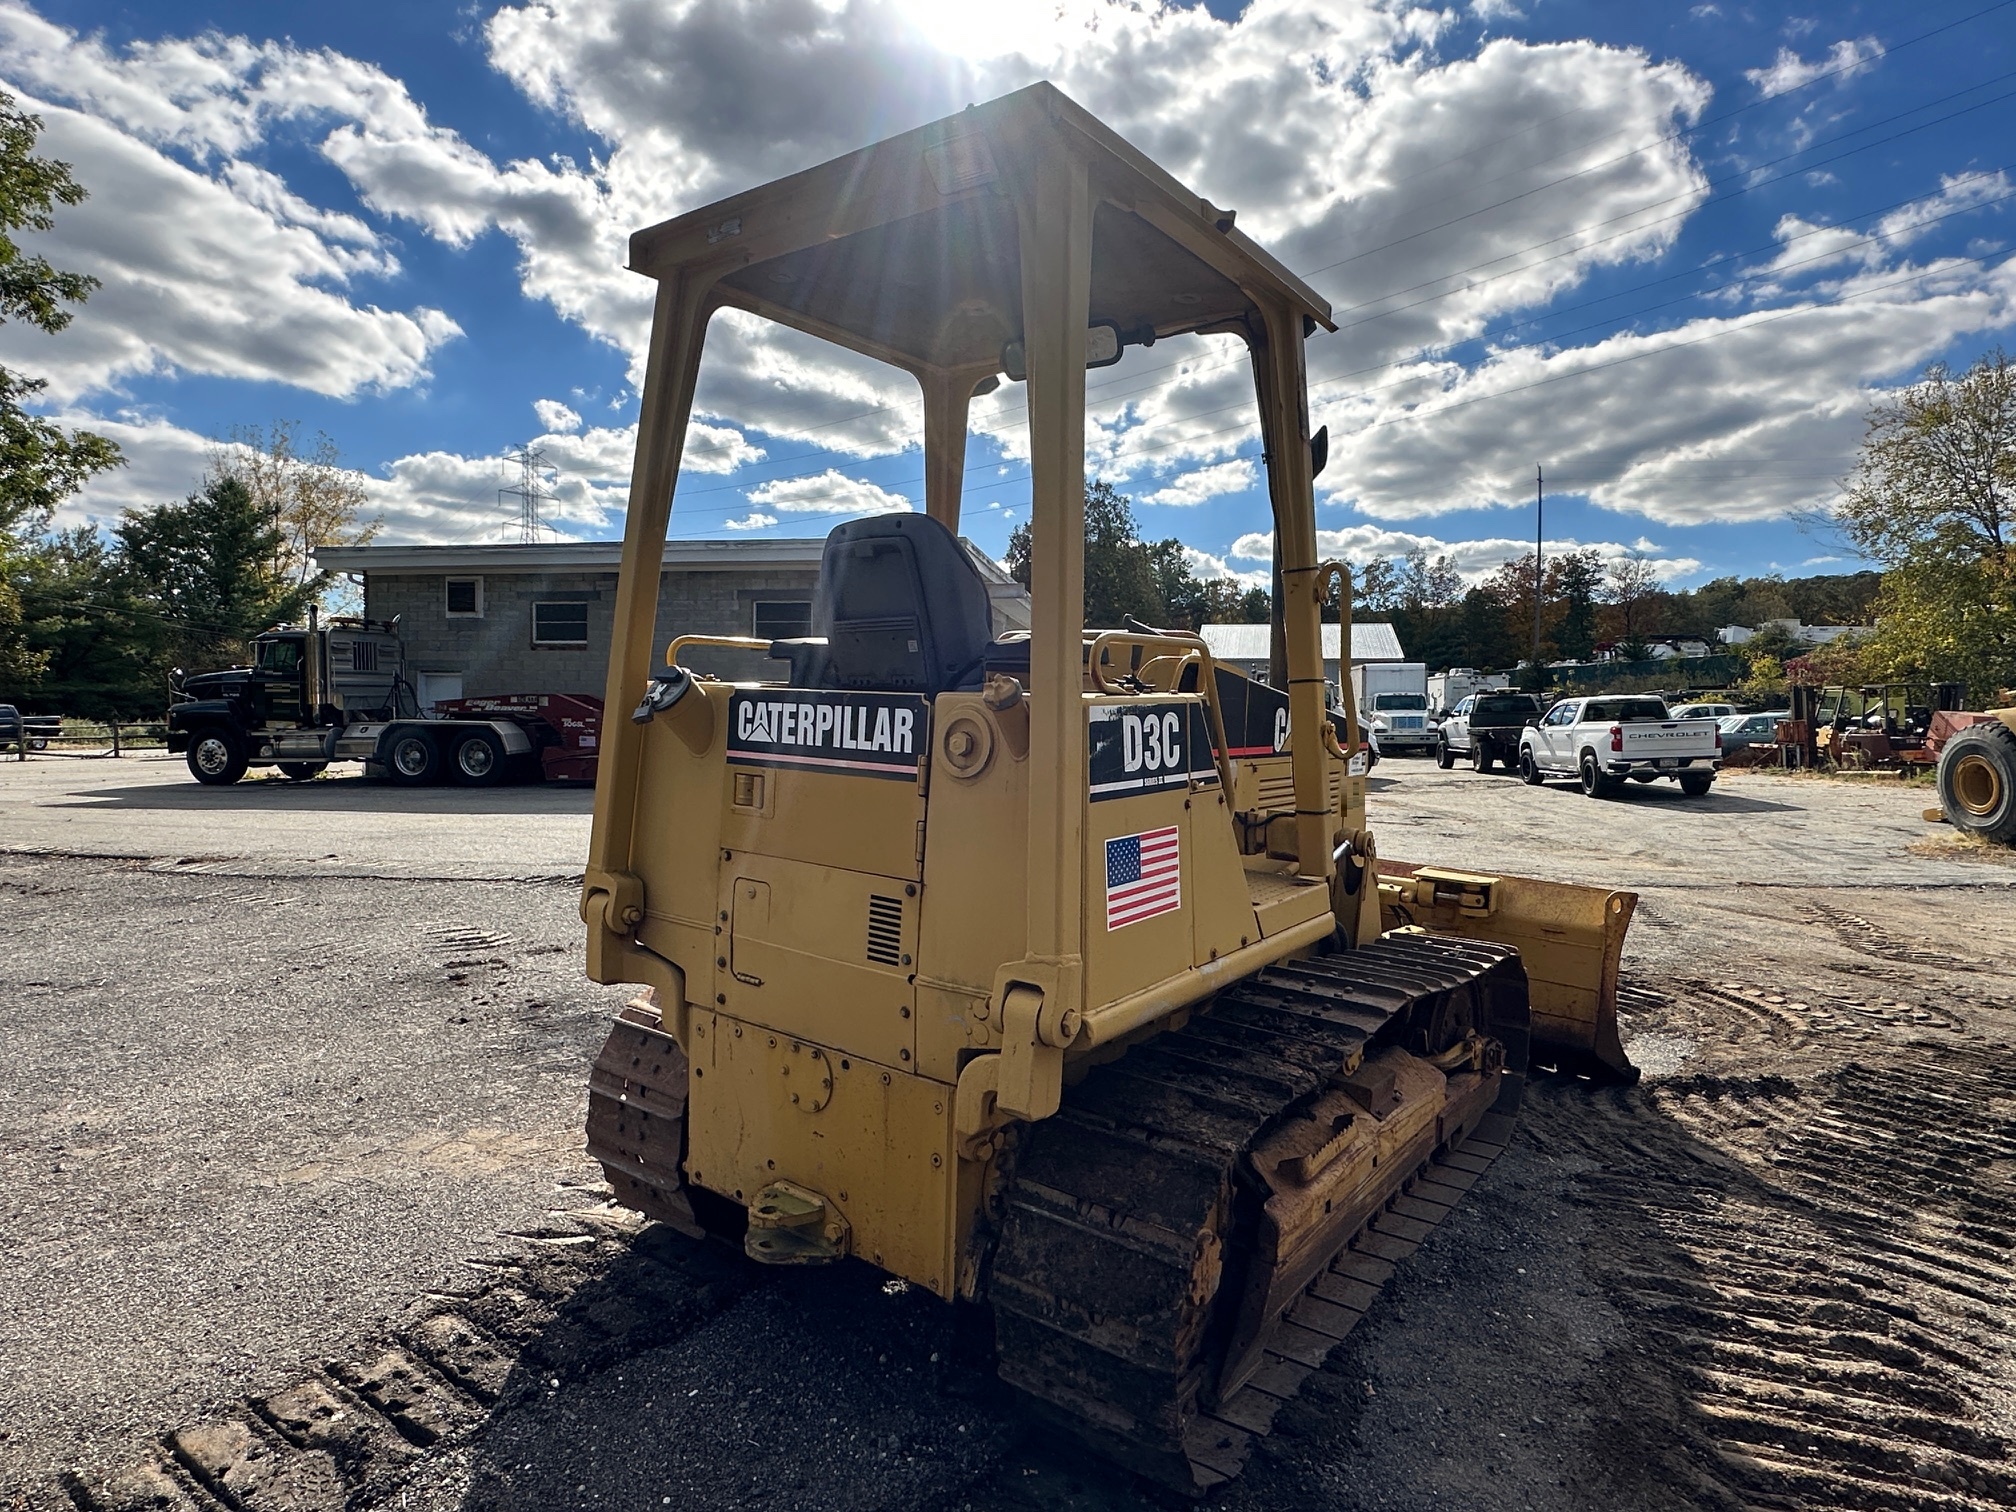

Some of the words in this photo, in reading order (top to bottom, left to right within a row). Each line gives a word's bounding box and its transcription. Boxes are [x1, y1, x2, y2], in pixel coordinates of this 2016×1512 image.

[737, 700, 914, 754] CATERPILLAR
[1123, 711, 1180, 772] D3C
[1629, 731, 1709, 739] CHEVROLET
